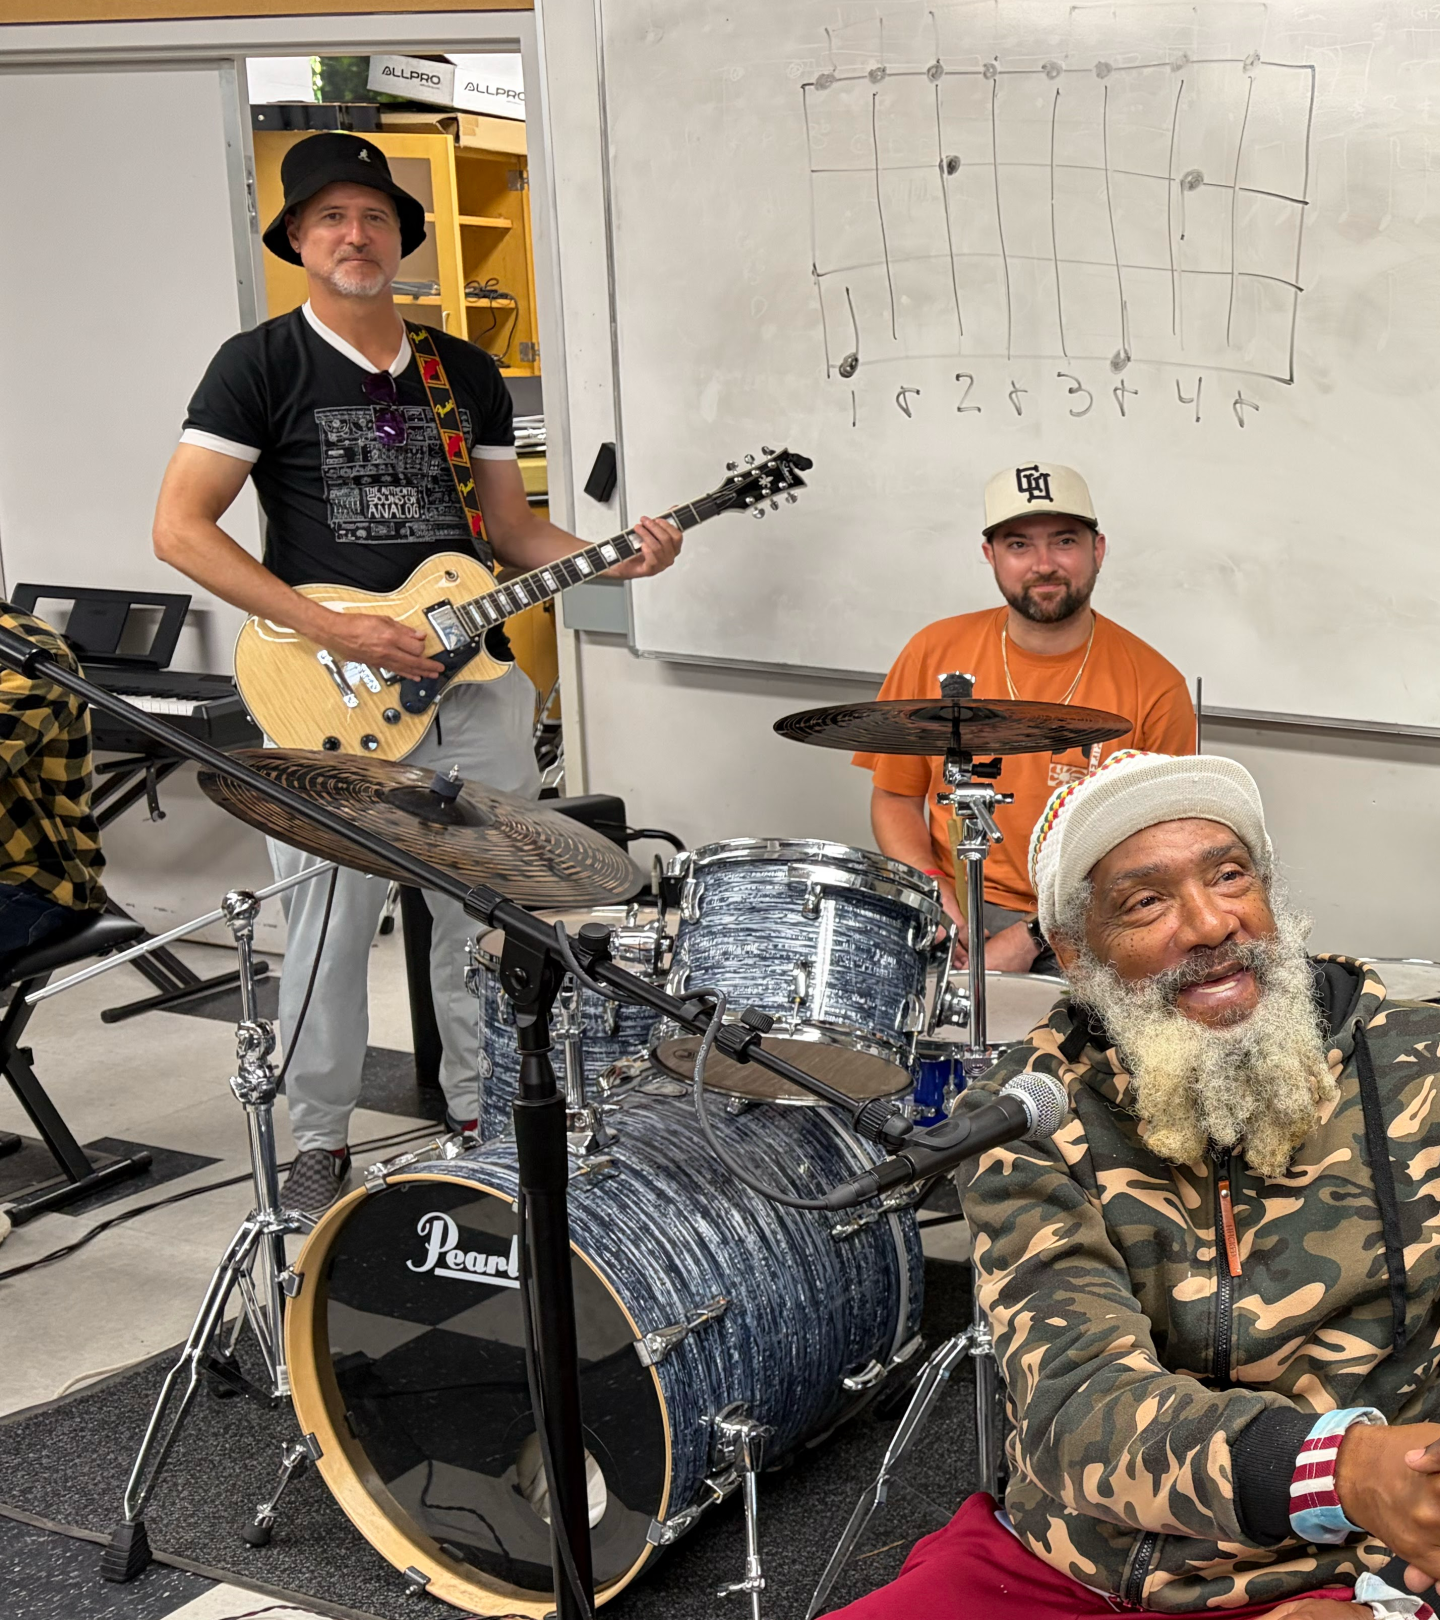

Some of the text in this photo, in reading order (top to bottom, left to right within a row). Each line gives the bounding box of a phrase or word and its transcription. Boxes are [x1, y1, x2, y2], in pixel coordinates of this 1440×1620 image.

[382, 66, 441, 86] ALLPRO
[956, 373, 981, 413] 2
[1056, 371, 1093, 417] 3
[1175, 376, 1202, 423] 4
[365, 486, 380, 495] THE
[367, 494, 404, 504] SOUND
[368, 504, 419, 518] ANALOG
[406, 1211, 520, 1278] Pearl
